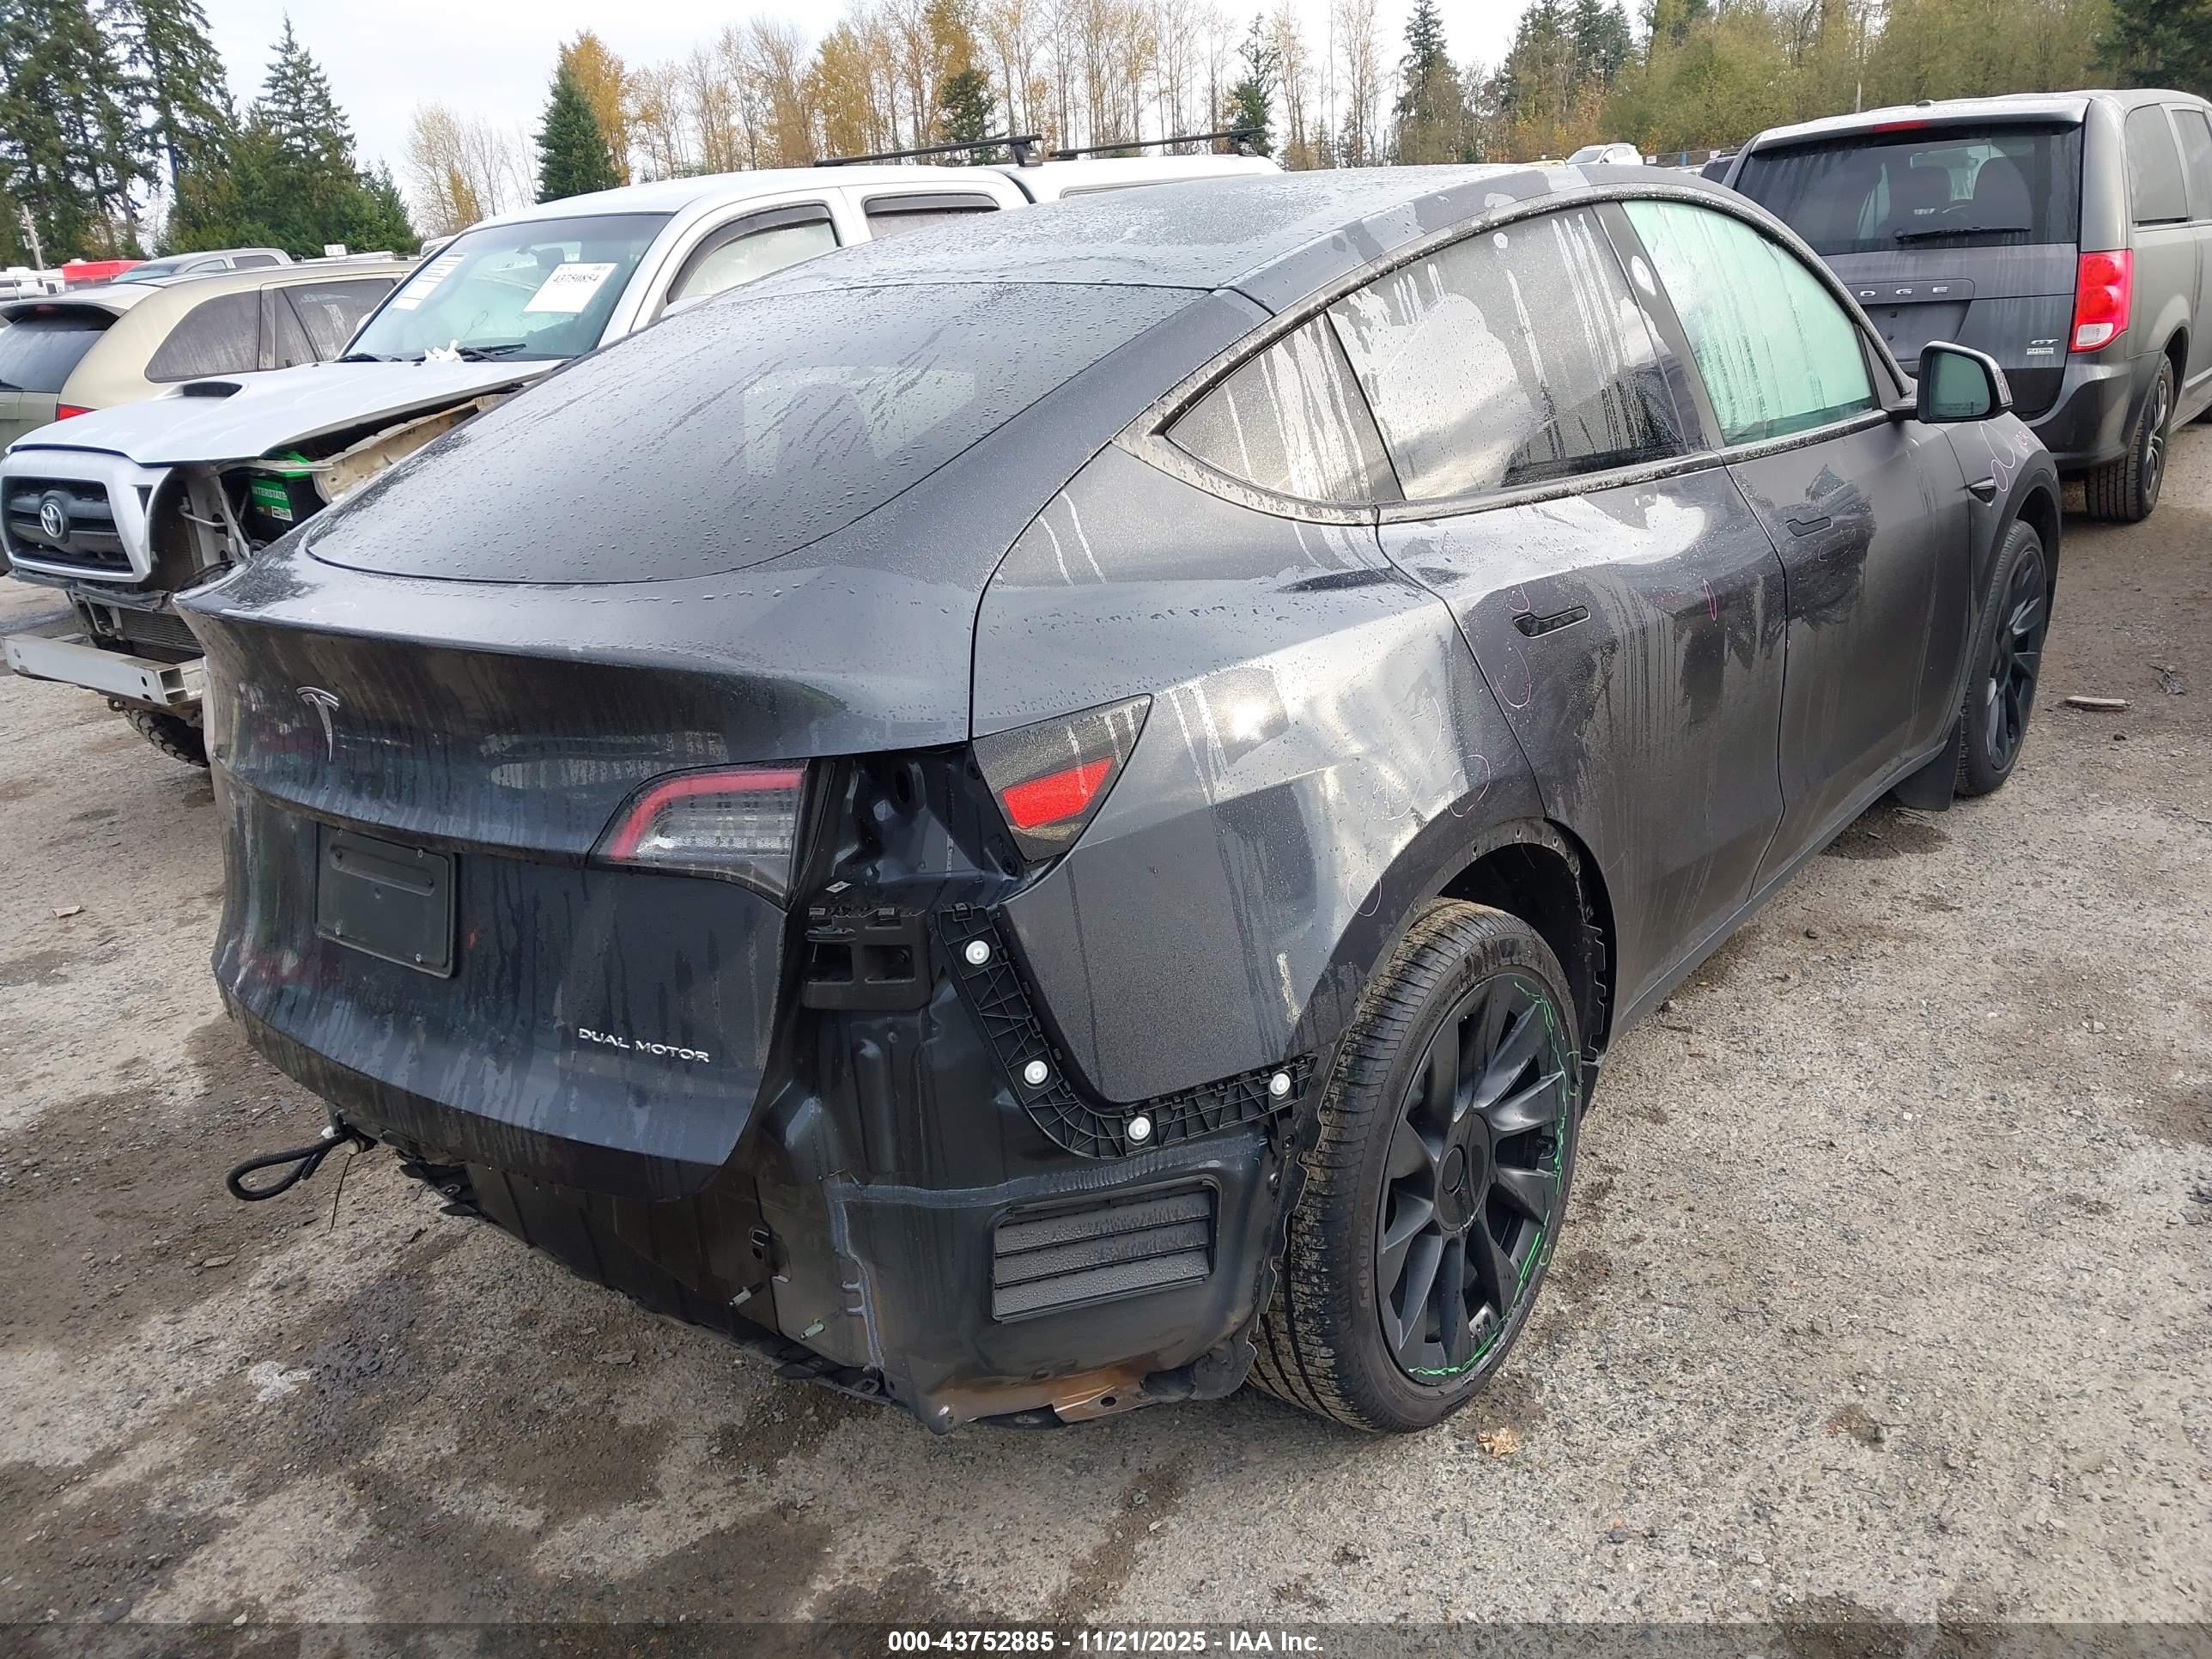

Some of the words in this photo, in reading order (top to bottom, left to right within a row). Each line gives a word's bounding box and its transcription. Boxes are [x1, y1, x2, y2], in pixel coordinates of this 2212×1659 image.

[1860, 286, 1949, 297] DGE
[578, 1028, 630, 1048] DUAL
[635, 1041, 710, 1063] MOTOR
